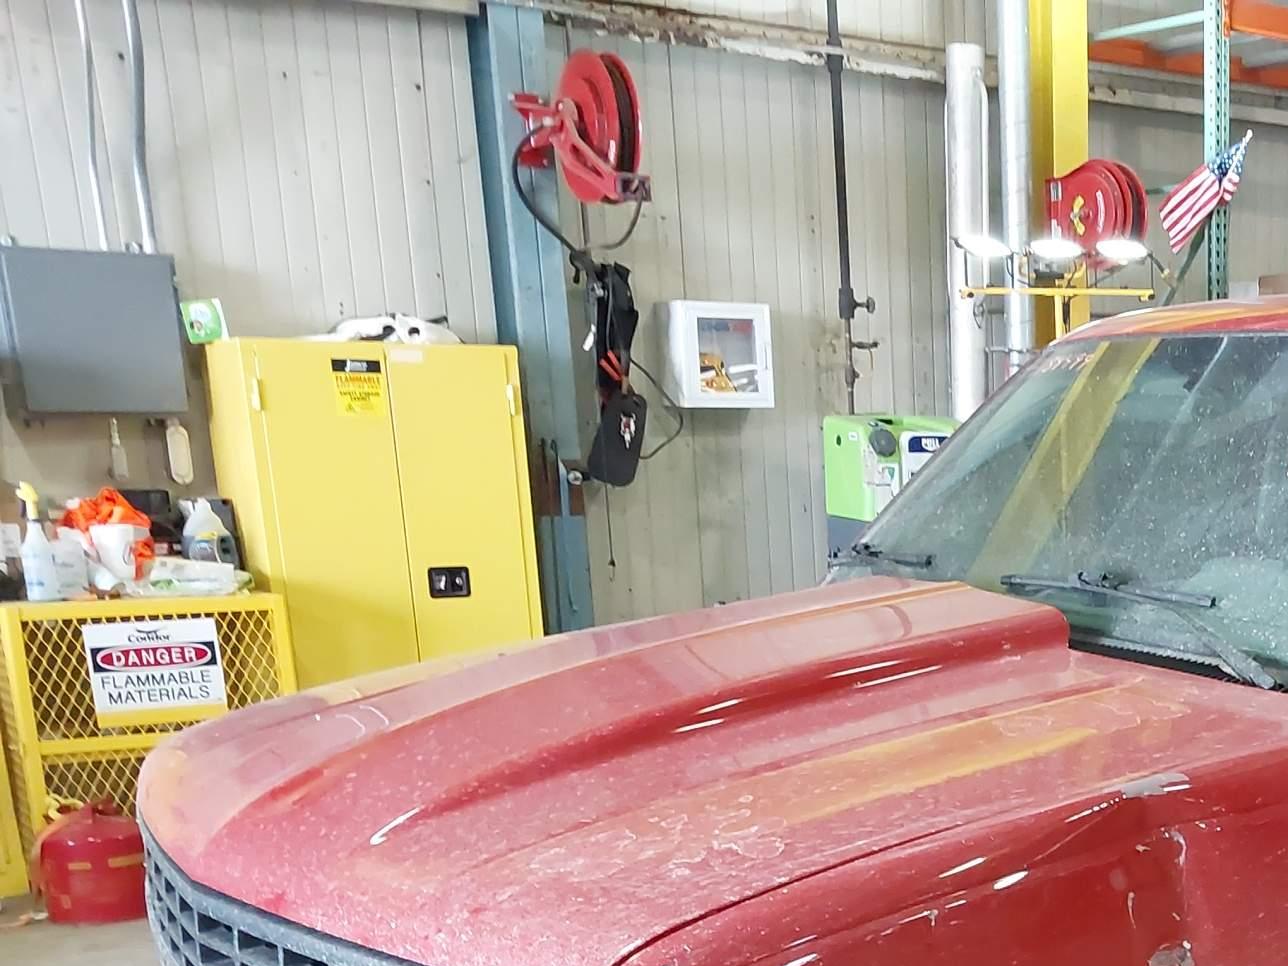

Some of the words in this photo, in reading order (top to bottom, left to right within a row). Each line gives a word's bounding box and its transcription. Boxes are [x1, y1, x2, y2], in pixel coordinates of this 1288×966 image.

[111, 646, 197, 668] DANGER
[100, 669, 213, 690] FLAMMABLE
[107, 685, 211, 706] MATERIALS
